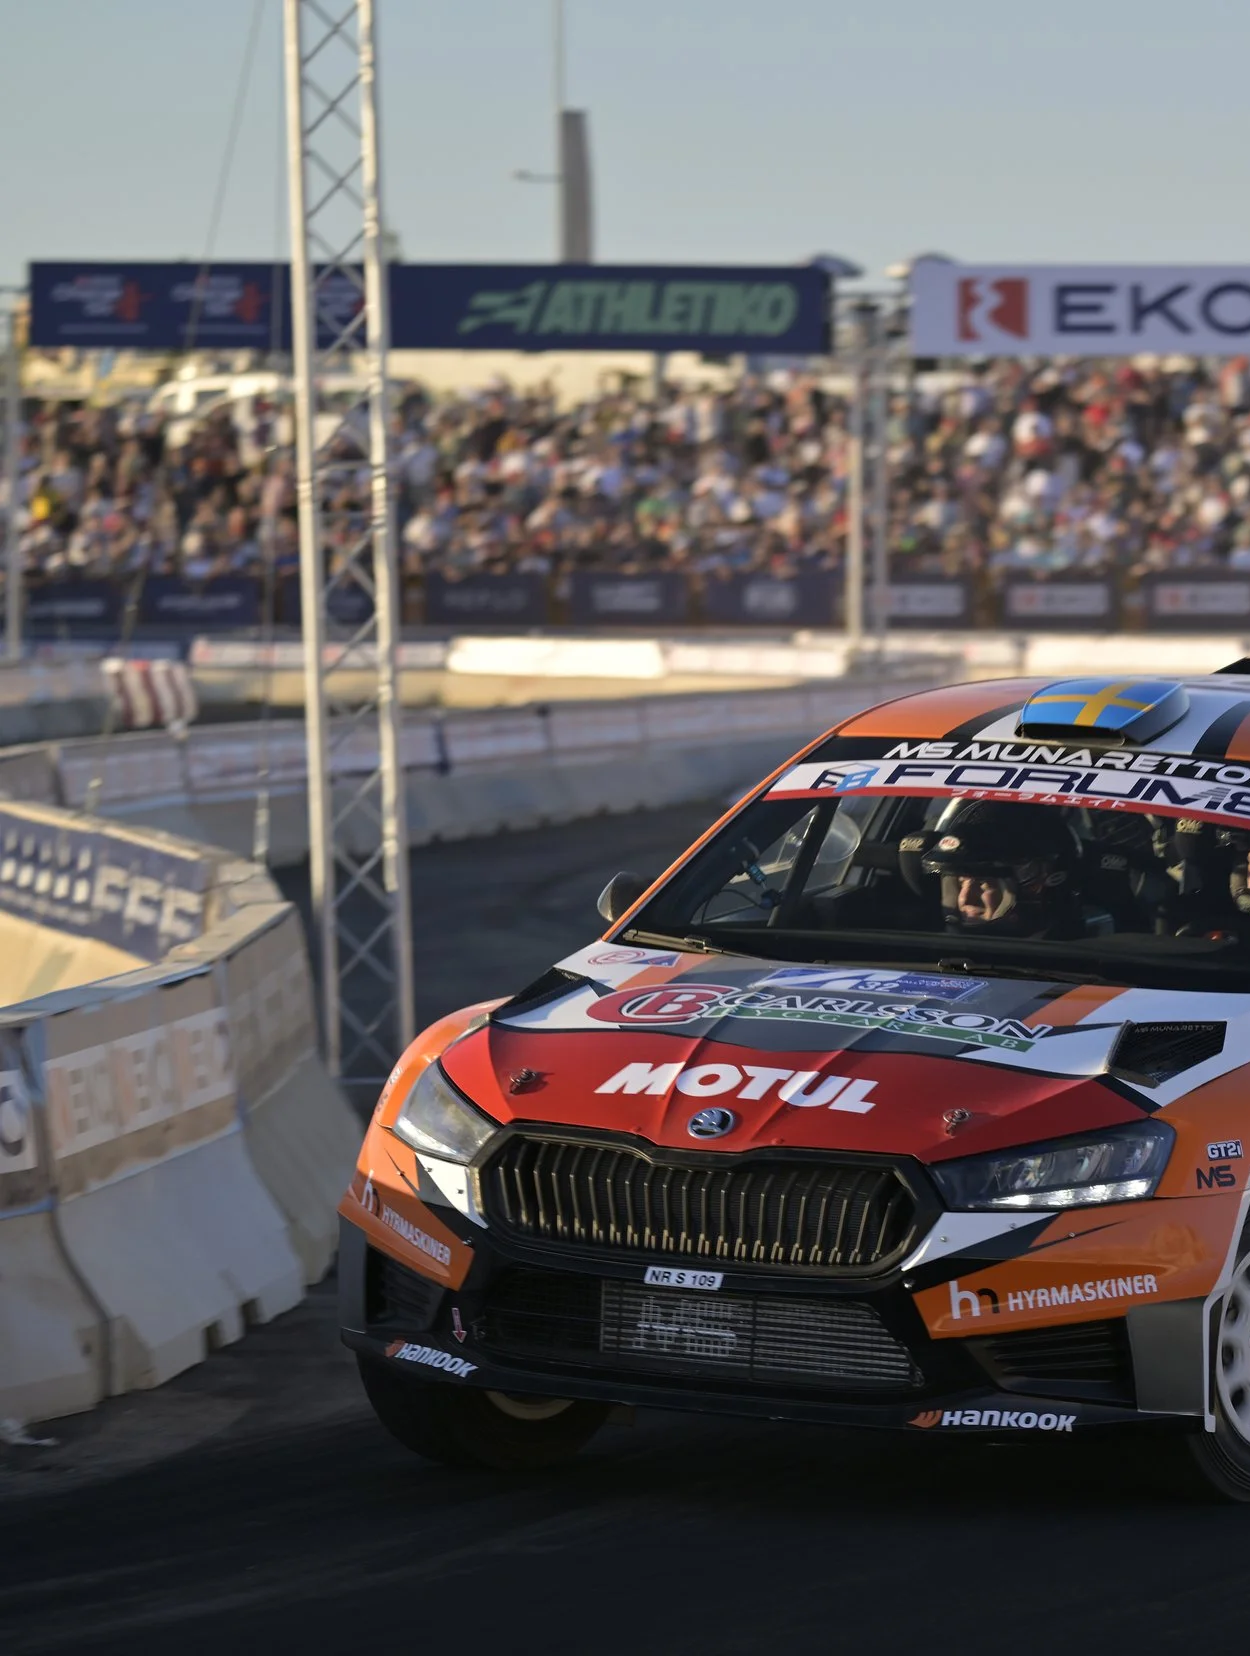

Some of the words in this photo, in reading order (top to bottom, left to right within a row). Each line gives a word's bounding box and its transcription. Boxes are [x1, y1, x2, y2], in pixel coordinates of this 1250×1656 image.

[535, 280, 797, 336] ATHLETIKO
[882, 741, 960, 759] MS
[858, 980, 899, 993] 32
[718, 991, 1054, 1040] CARLSSON
[963, 1033, 1018, 1050] AB
[593, 1062, 879, 1114] MOTUL
[381, 1204, 452, 1266] HYRMASKINER
[649, 1269, 672, 1283] NR
[675, 1272, 687, 1284] S
[690, 1273, 716, 1287] 109
[1007, 1273, 1159, 1312] HYRMASKINER
